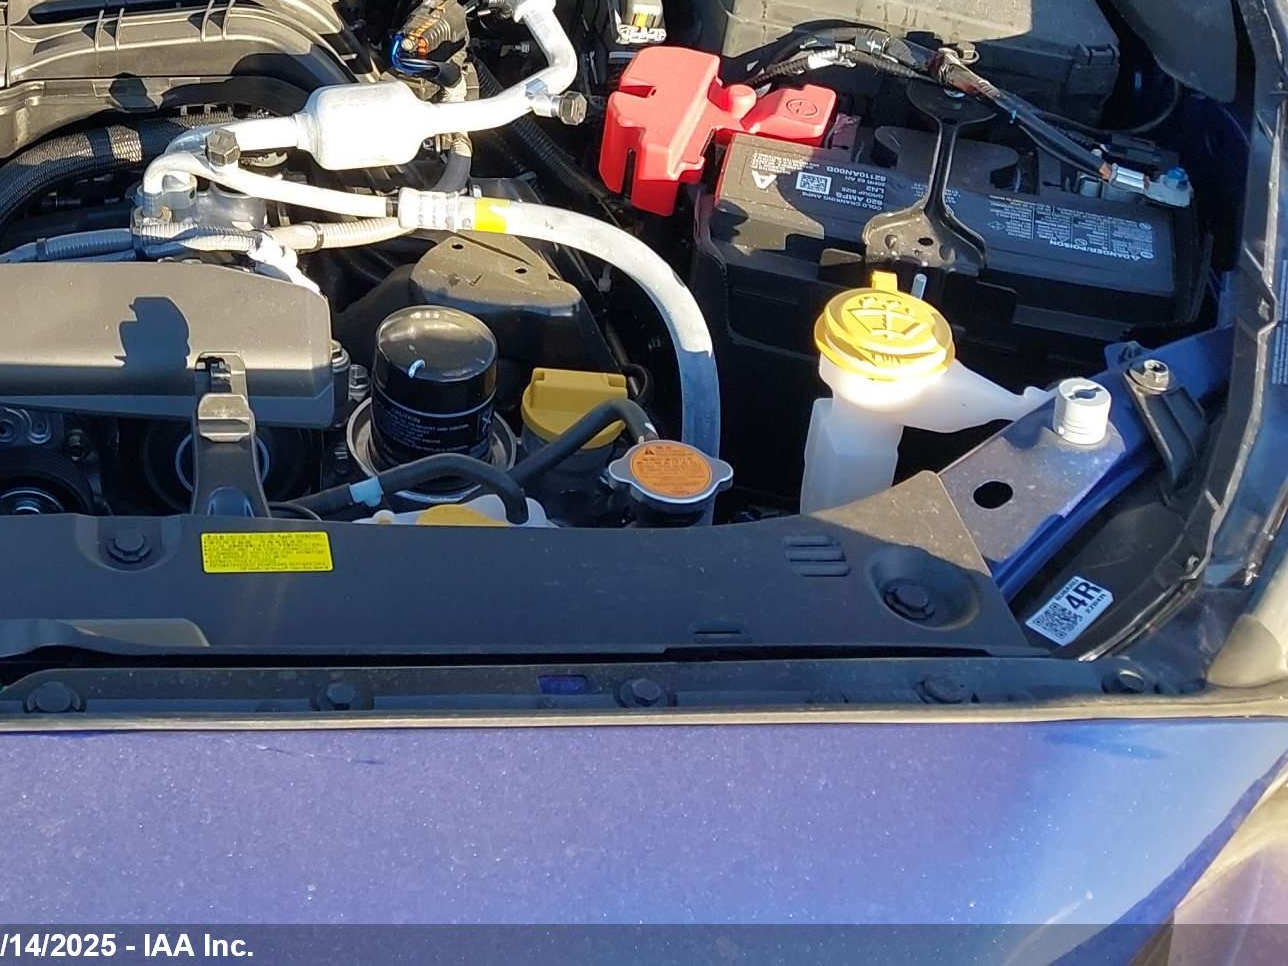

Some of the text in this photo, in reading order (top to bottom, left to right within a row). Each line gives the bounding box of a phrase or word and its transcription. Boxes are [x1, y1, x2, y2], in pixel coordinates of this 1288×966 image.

[802, 191, 822, 199] AMPS
[836, 191, 864, 202] AMPS
[1066, 581, 1103, 611] 4R
